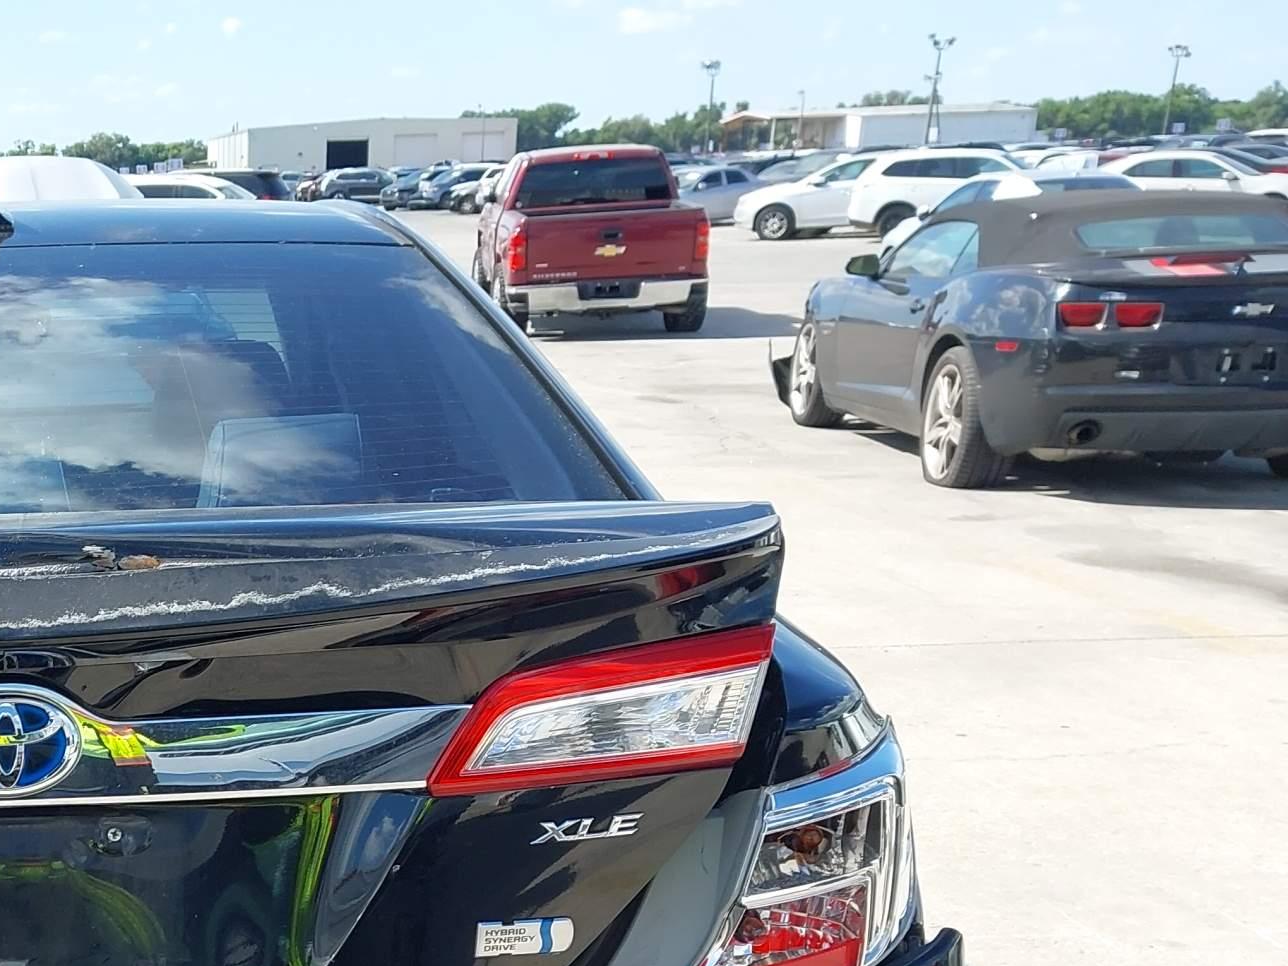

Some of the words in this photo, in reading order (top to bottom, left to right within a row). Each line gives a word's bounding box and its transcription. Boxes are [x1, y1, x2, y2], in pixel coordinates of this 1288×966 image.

[530, 812, 644, 844] XLE
[485, 928, 526, 936] HYBRID
[485, 936, 535, 944] SYNERGY
[484, 944, 517, 952] DRIVE
